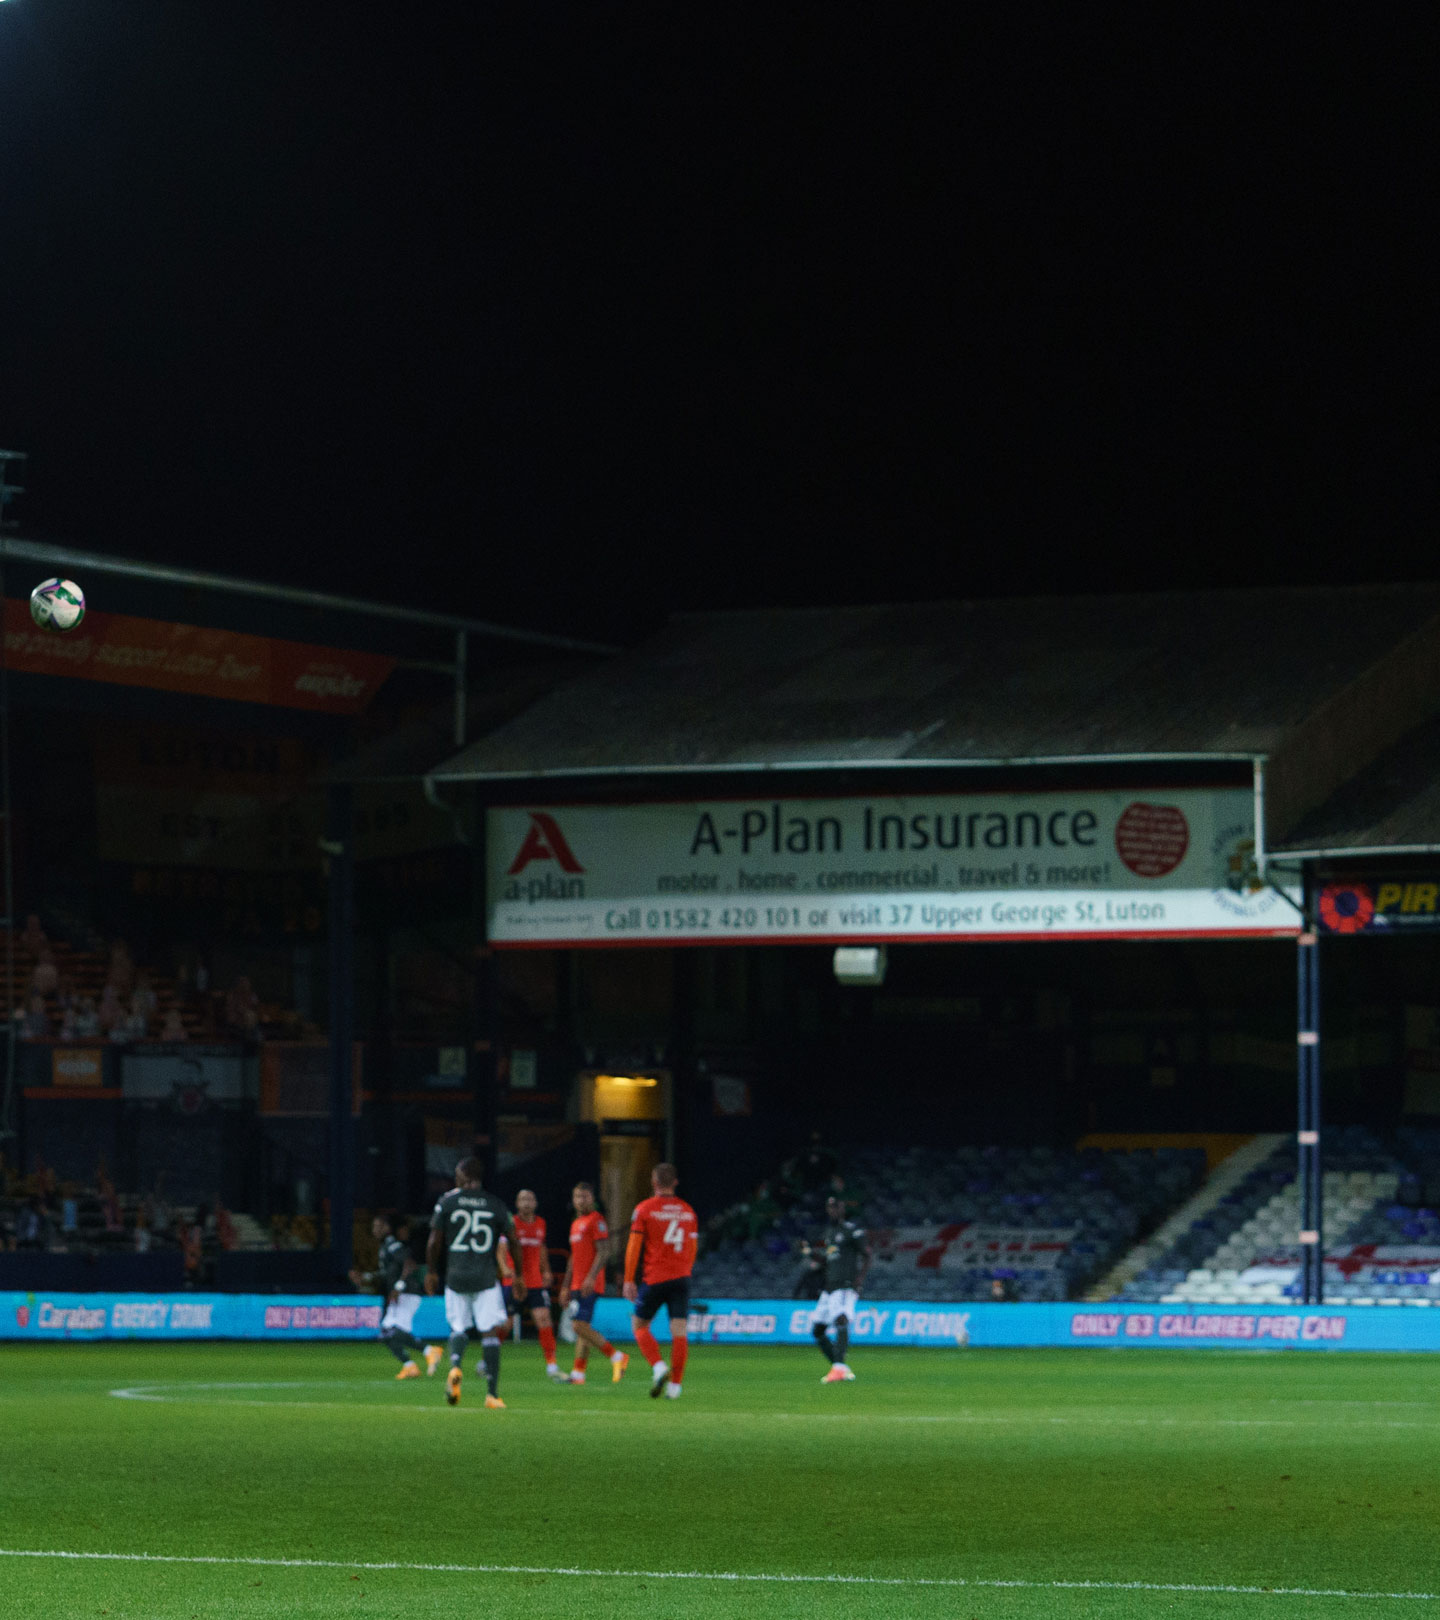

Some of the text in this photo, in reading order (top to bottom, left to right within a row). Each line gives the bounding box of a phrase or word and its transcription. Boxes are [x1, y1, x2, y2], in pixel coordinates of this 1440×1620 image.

[690, 803, 841, 854] A-Plan
[866, 807, 1097, 851] Insurance
[658, 862, 1109, 891] motor home commercial travel & more!
[605, 907, 641, 930] Call
[647, 907, 710, 929] 01582
[719, 907, 758, 928] 420
[766, 906, 800, 927] 101
[809, 909, 829, 926] or
[840, 903, 881, 926] visit
[890, 904, 913, 926] 37
[921, 904, 983, 928] Upper
[992, 902, 1067, 927] George
[1106, 900, 1166, 921] Luton
[450, 1209, 494, 1253] 25
[663, 1220, 685, 1253] 4
[687, 1310, 776, 1334] arabao
[893, 1311, 970, 1337] DRINK
[1072, 1314, 1122, 1336] ONLY
[1159, 1315, 1255, 1339] CALORIES
[1257, 1315, 1301, 1338] PER
[1301, 1316, 1347, 1339] CAN
